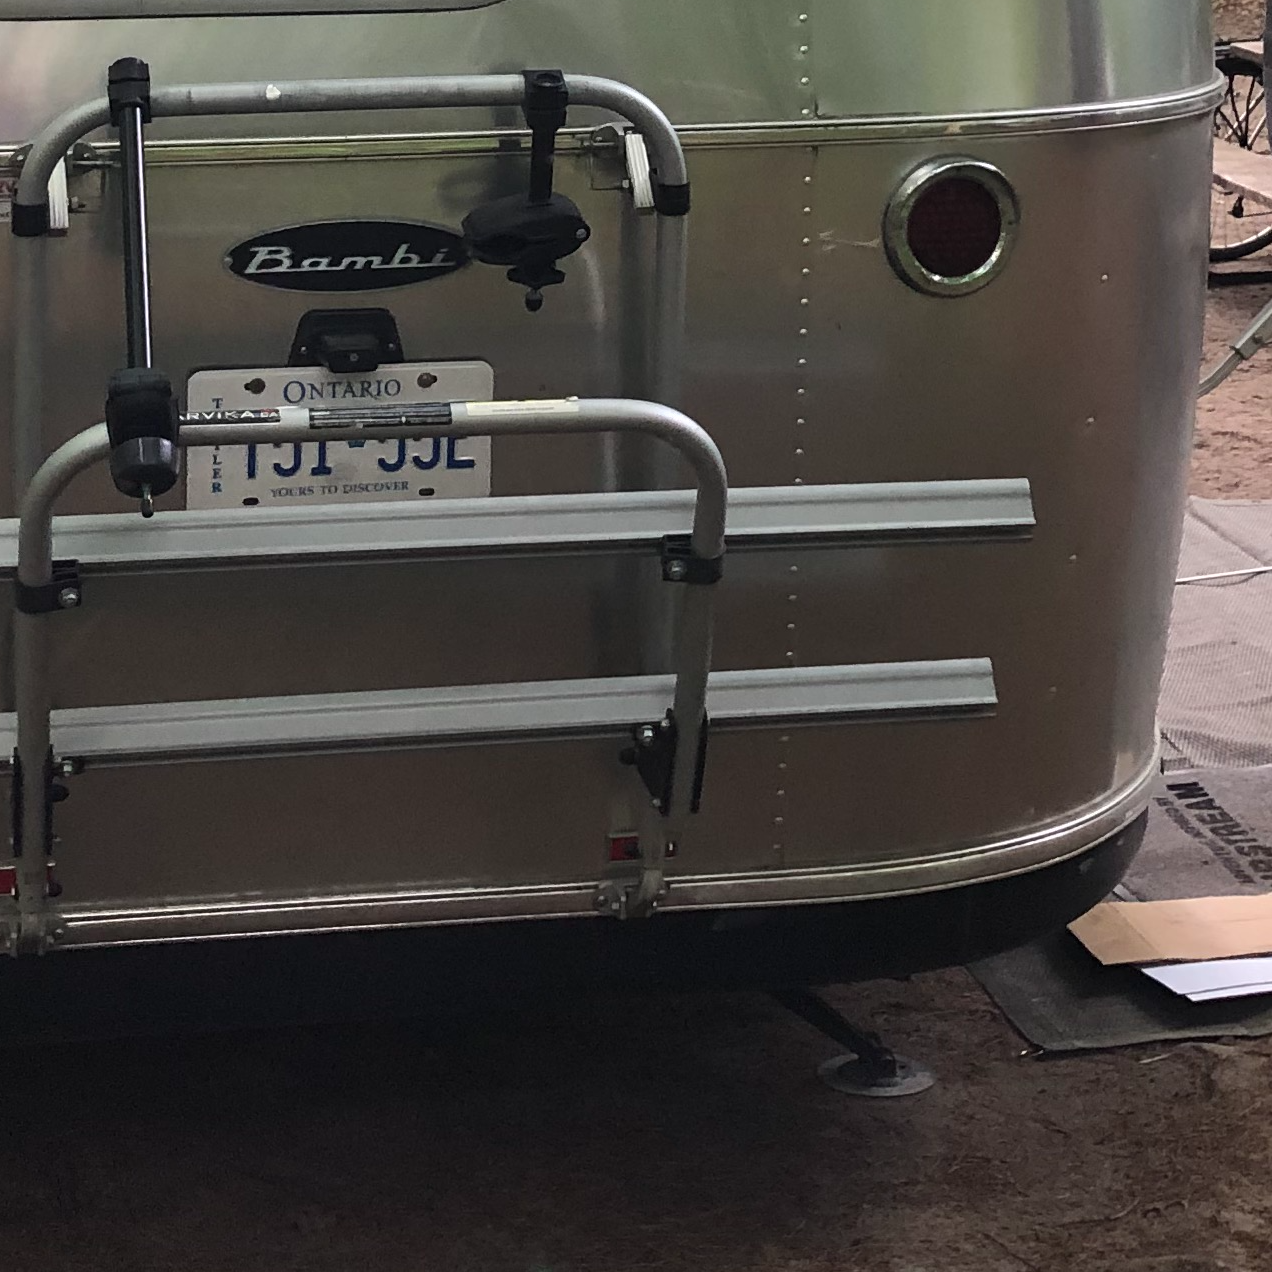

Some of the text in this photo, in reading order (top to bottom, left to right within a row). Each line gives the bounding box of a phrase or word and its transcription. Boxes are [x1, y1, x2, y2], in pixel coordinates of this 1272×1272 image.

[244, 243, 456, 274] Bambi
[271, 481, 409, 497] YOURS TO DISCOVER
